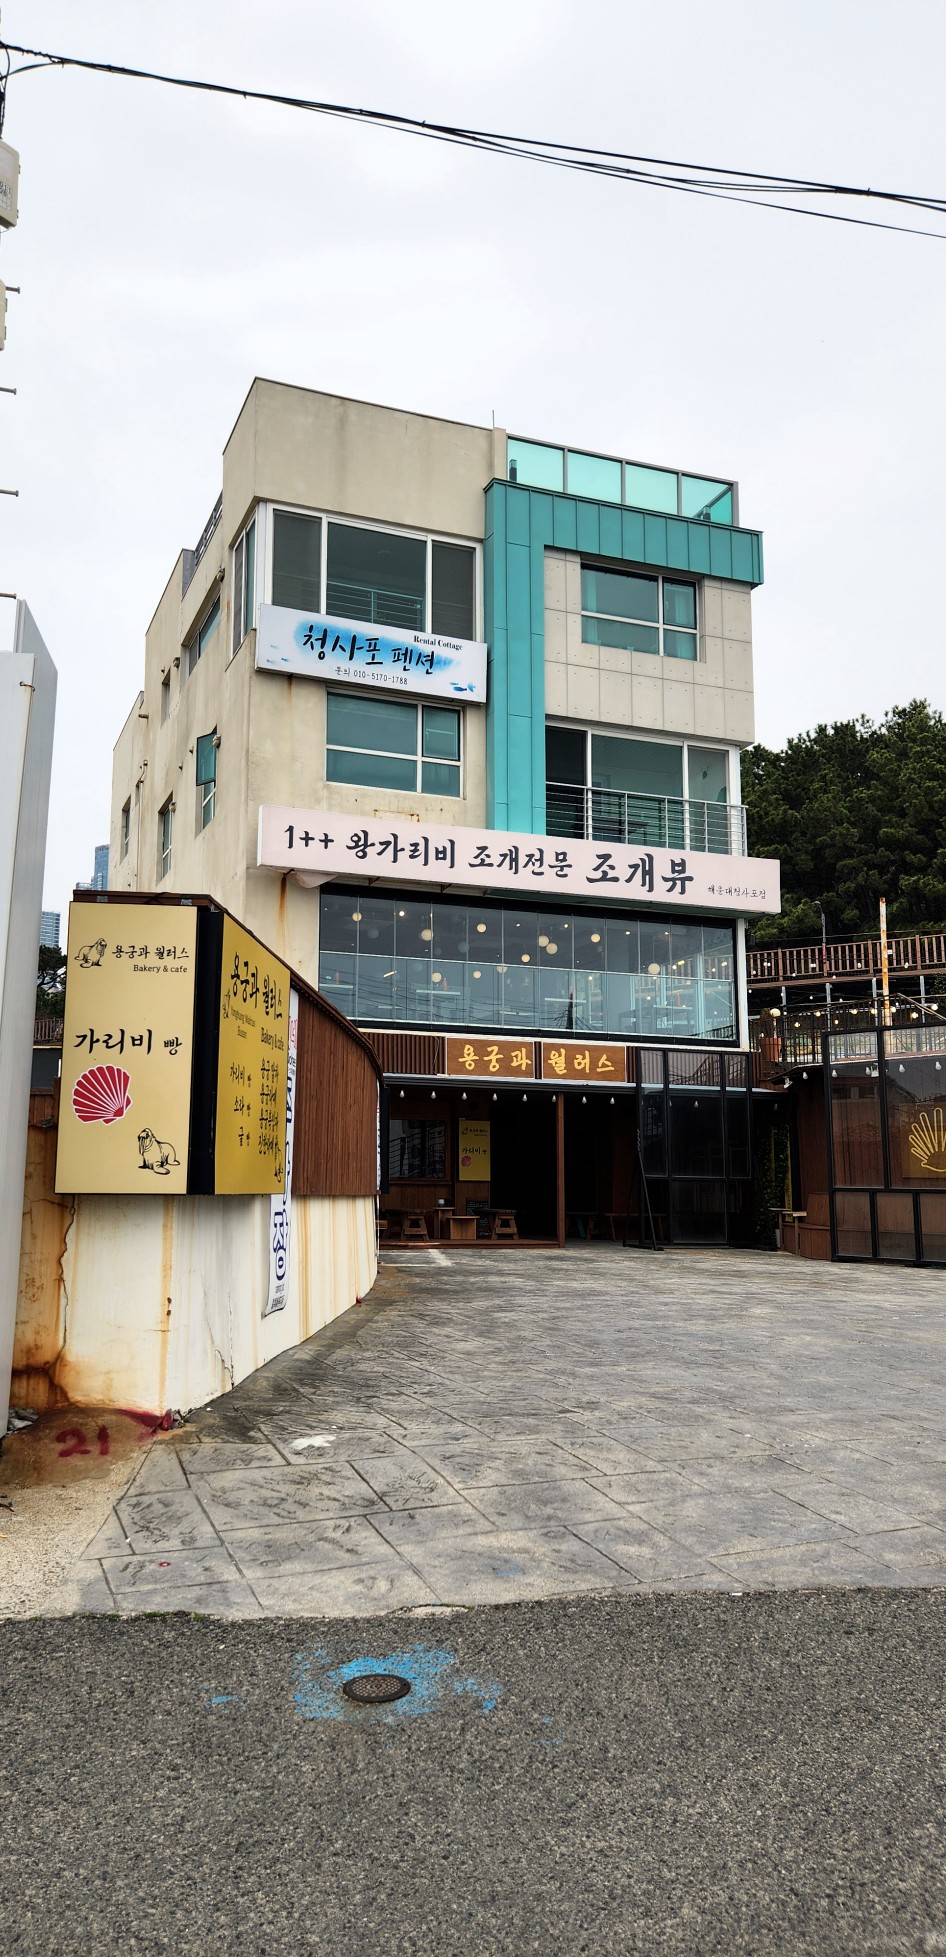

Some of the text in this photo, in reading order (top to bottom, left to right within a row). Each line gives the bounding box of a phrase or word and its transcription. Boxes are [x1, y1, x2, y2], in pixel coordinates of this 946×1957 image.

[303, 624, 435, 675] 청사포 펜션
[414, 635, 463, 651] Rental Cottage
[335, 666, 408, 685] 문의 010-5170-1788
[284, 825, 694, 896] 1++ 왕가리비 조개전문 조개뷰
[112, 945, 189, 960] 용궁과 월러스
[133, 964, 187, 974] Bakery & cafe
[231, 952, 283, 1020] 용궁과 월러스
[74, 1027, 183, 1055] 가리비 빵
[261, 1027, 274, 1050] Bakery
[458, 1044, 616, 1076] 용궁과 월러스
[230, 1062, 246, 1087] 가리비
[233, 1095, 245, 1116] 소라
[55, 1424, 110, 1458] 21
